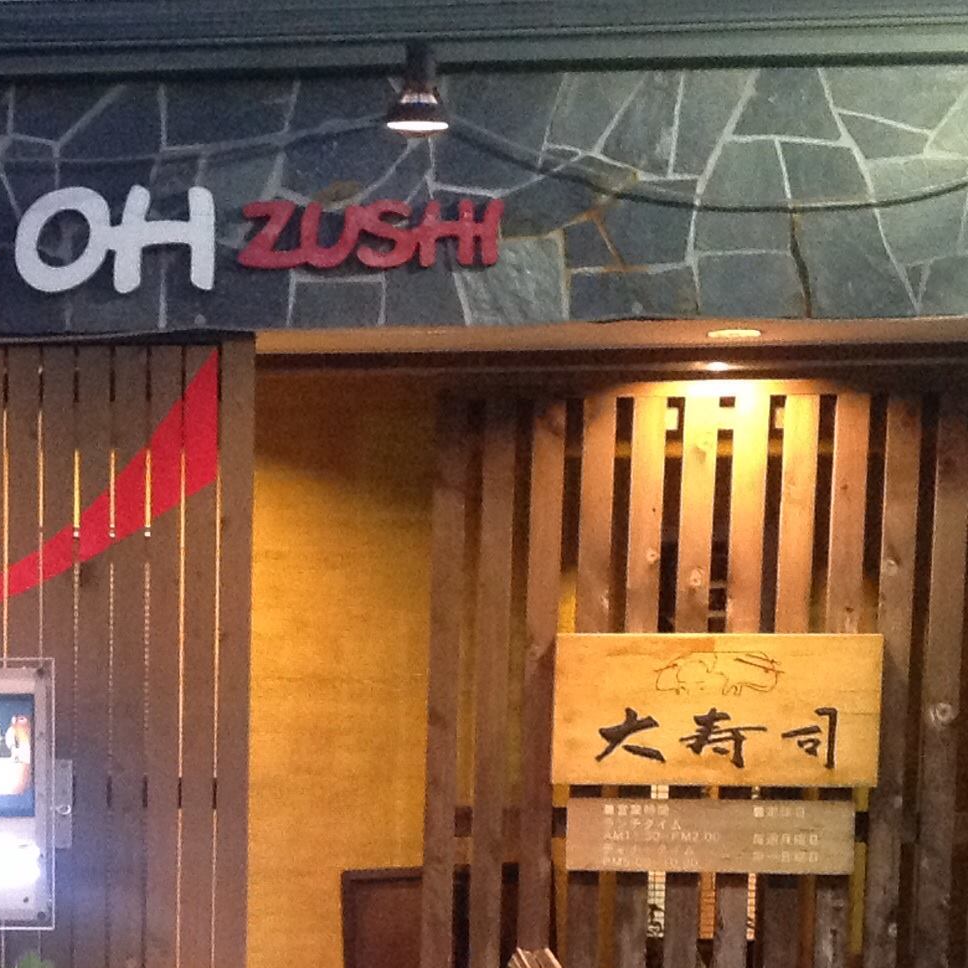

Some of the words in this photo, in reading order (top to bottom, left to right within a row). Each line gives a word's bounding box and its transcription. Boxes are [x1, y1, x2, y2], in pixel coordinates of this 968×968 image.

[15, 185, 216, 293] OH
[238, 199, 506, 269] ZUSHI
[595, 706, 838, 769] 大寿司
